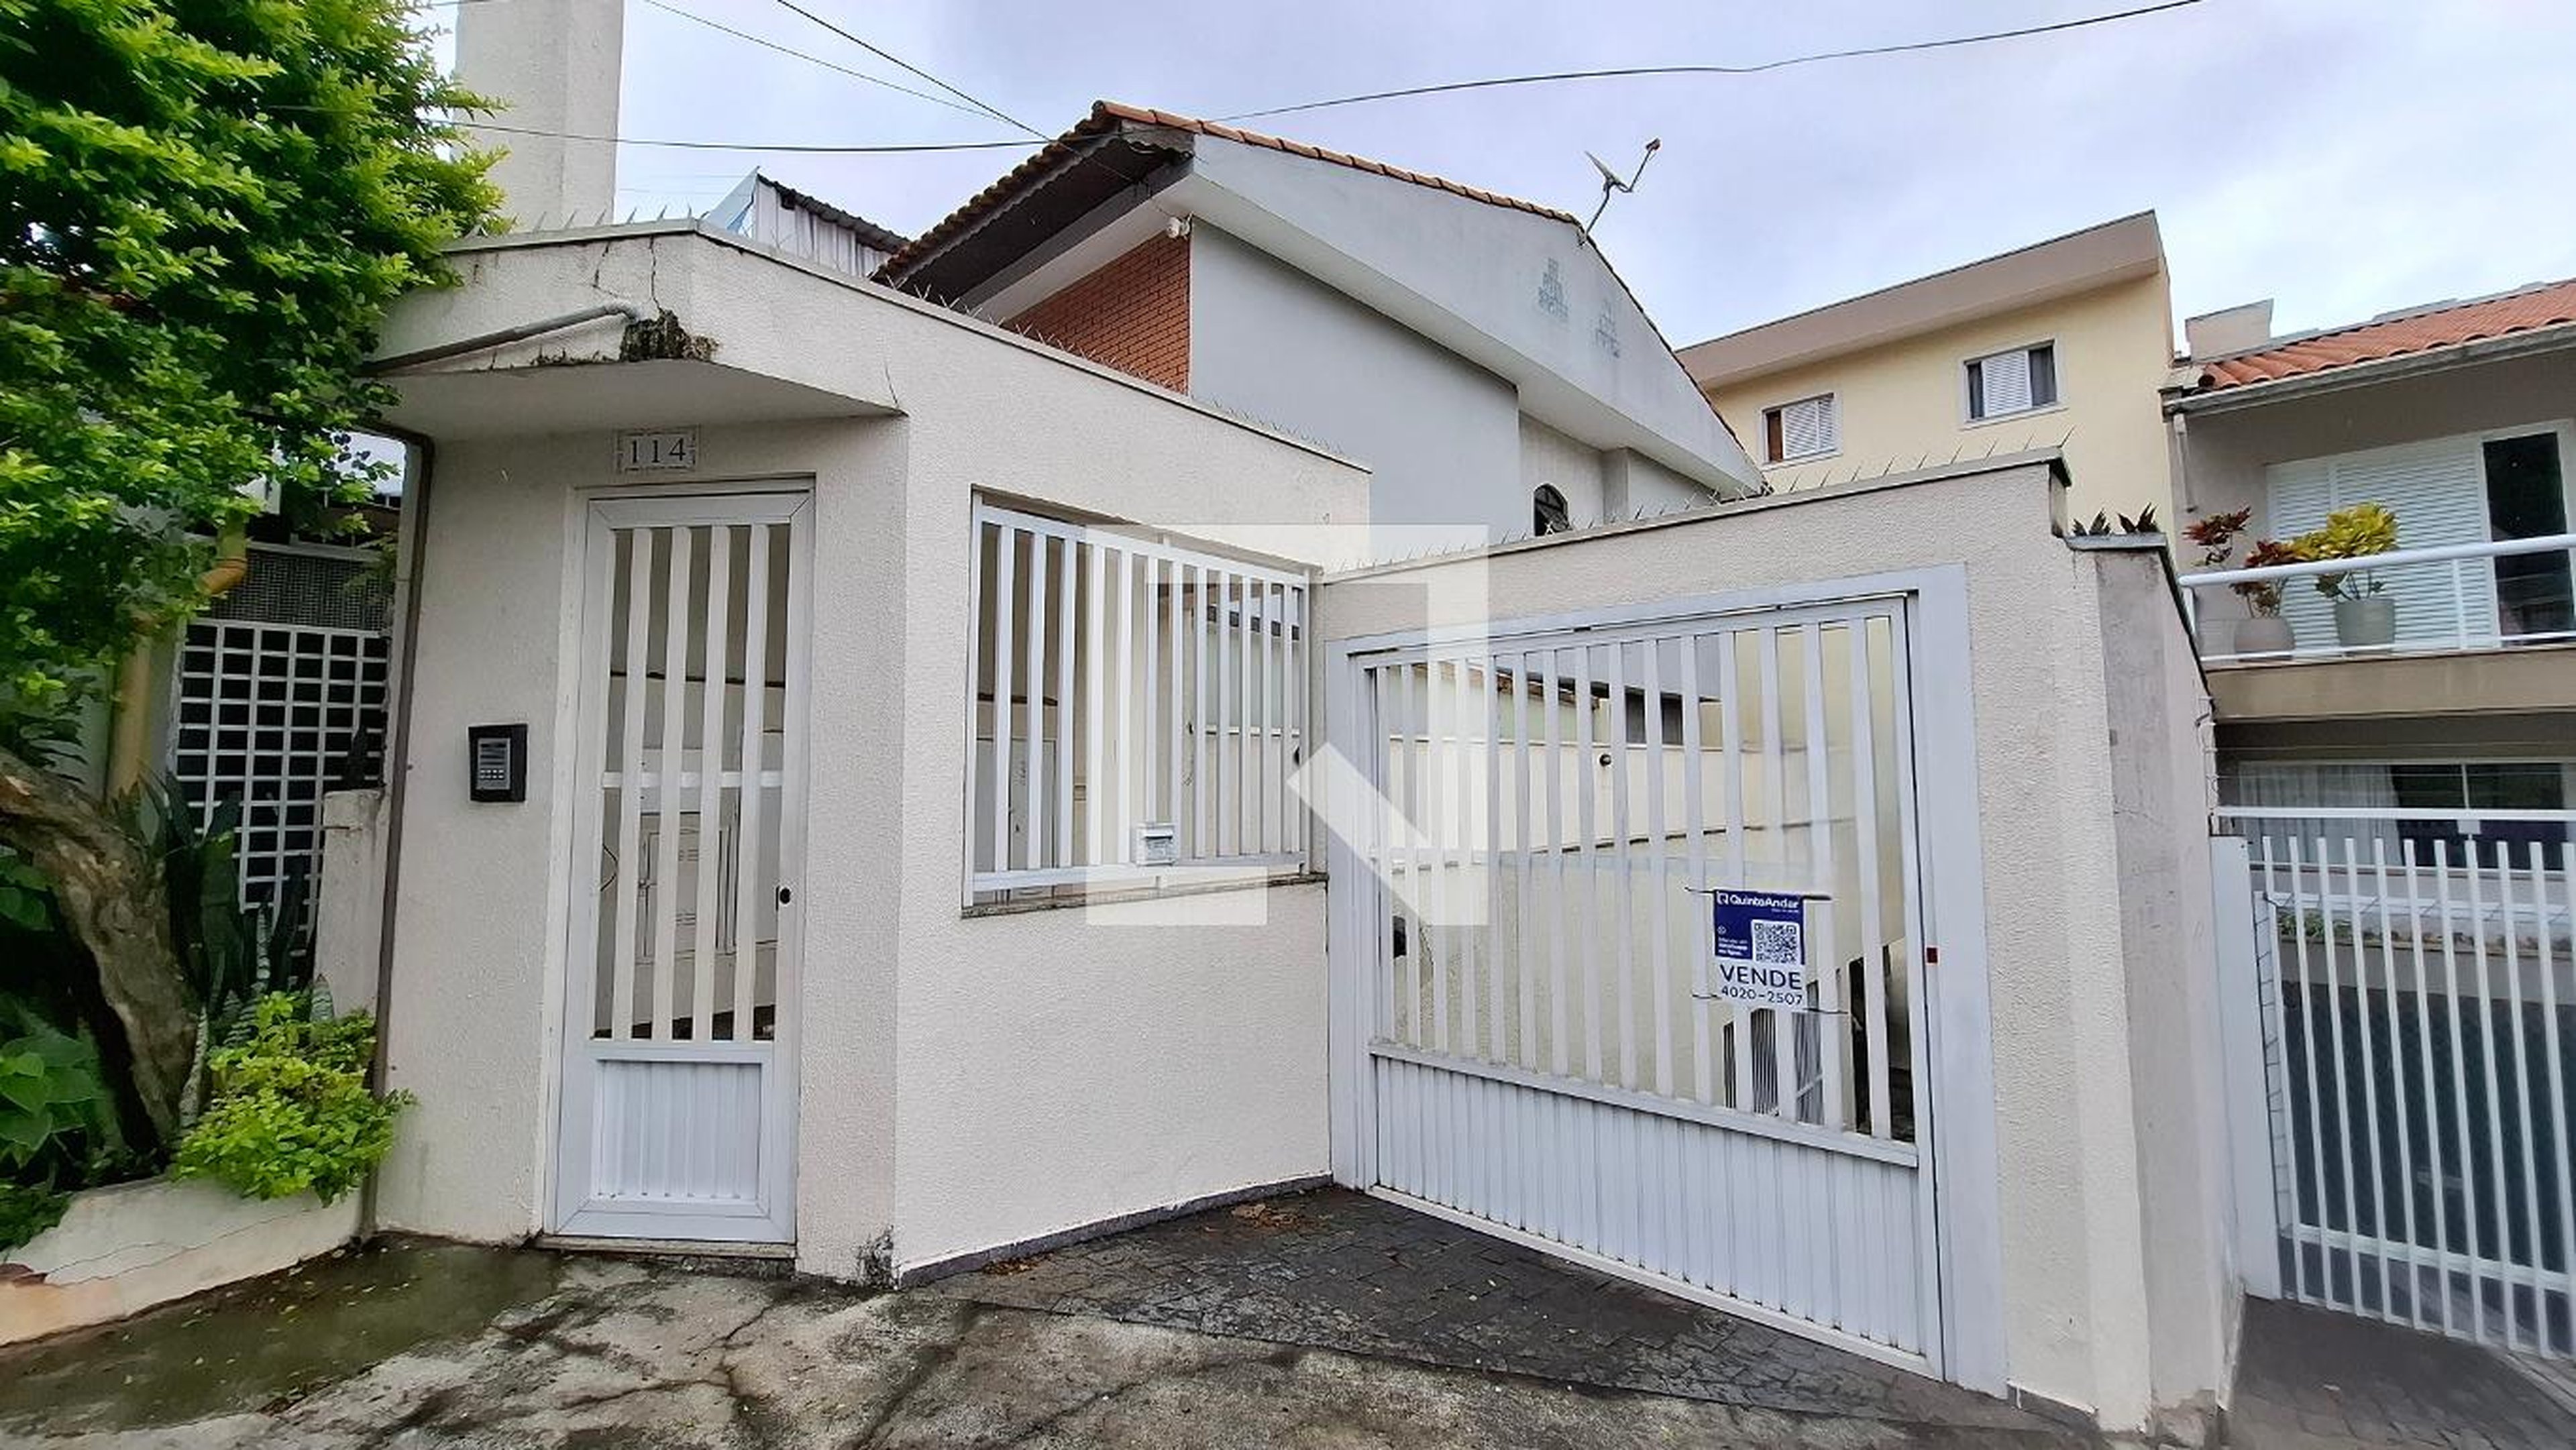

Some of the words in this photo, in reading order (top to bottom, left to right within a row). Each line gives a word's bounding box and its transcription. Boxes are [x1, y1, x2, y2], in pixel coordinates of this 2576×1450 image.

[632, 437, 687, 463] 114
[1729, 894, 1799, 908] QuintoAndar
[1719, 964, 1803, 991] VENDE
[1721, 985, 1803, 1005] 4020-2507
